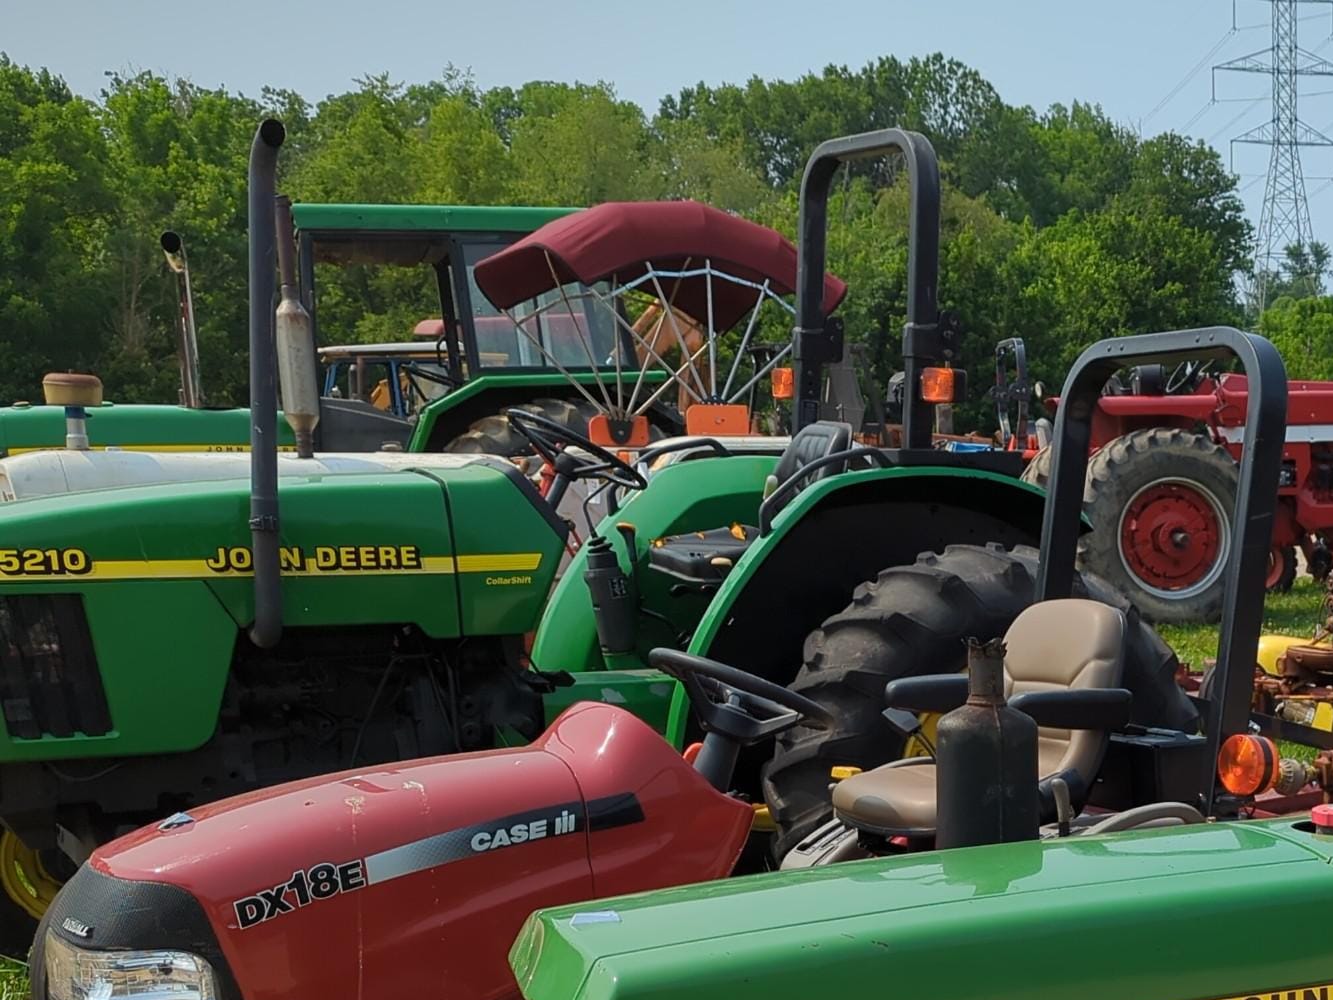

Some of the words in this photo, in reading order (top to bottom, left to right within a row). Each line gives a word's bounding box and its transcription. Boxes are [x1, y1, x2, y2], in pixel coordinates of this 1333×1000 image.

[0, 548, 89, 574] 5210
[206, 546, 305, 572] JON
[315, 545, 421, 571] DEERE
[233, 858, 368, 929] DX18E
[471, 818, 548, 851] CASE
